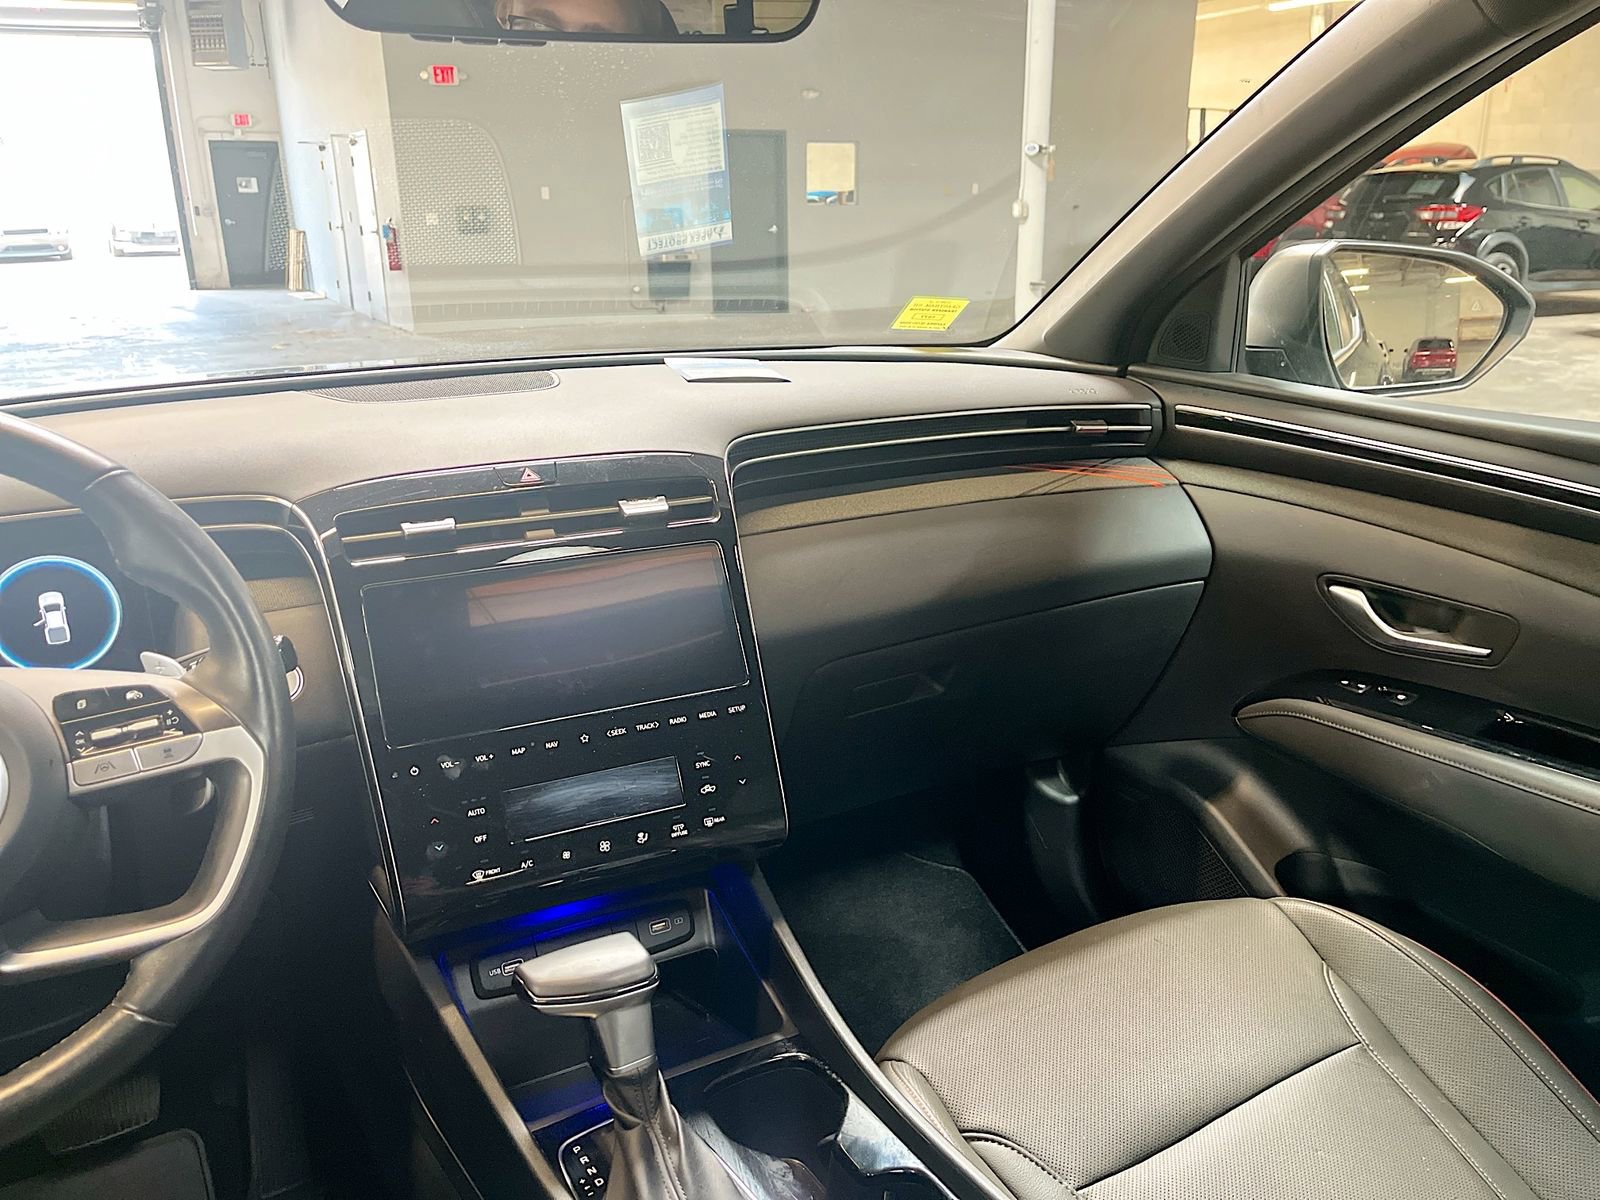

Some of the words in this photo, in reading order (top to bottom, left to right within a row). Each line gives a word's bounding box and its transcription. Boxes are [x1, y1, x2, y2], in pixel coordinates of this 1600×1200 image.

[433, 66, 454, 84] EXIT
[728, 705, 746, 713] SETUP
[699, 711, 717, 719] MEDIA
[669, 717, 687, 725] RADIO
[512, 747, 525, 755] MAP
[695, 761, 710, 769] SYNC
[467, 808, 485, 817] AUTO
[474, 835, 487, 843] OFF
[521, 860, 534, 869] A/C
[485, 868, 500, 876] FRONT
[489, 968, 501, 976] USB
